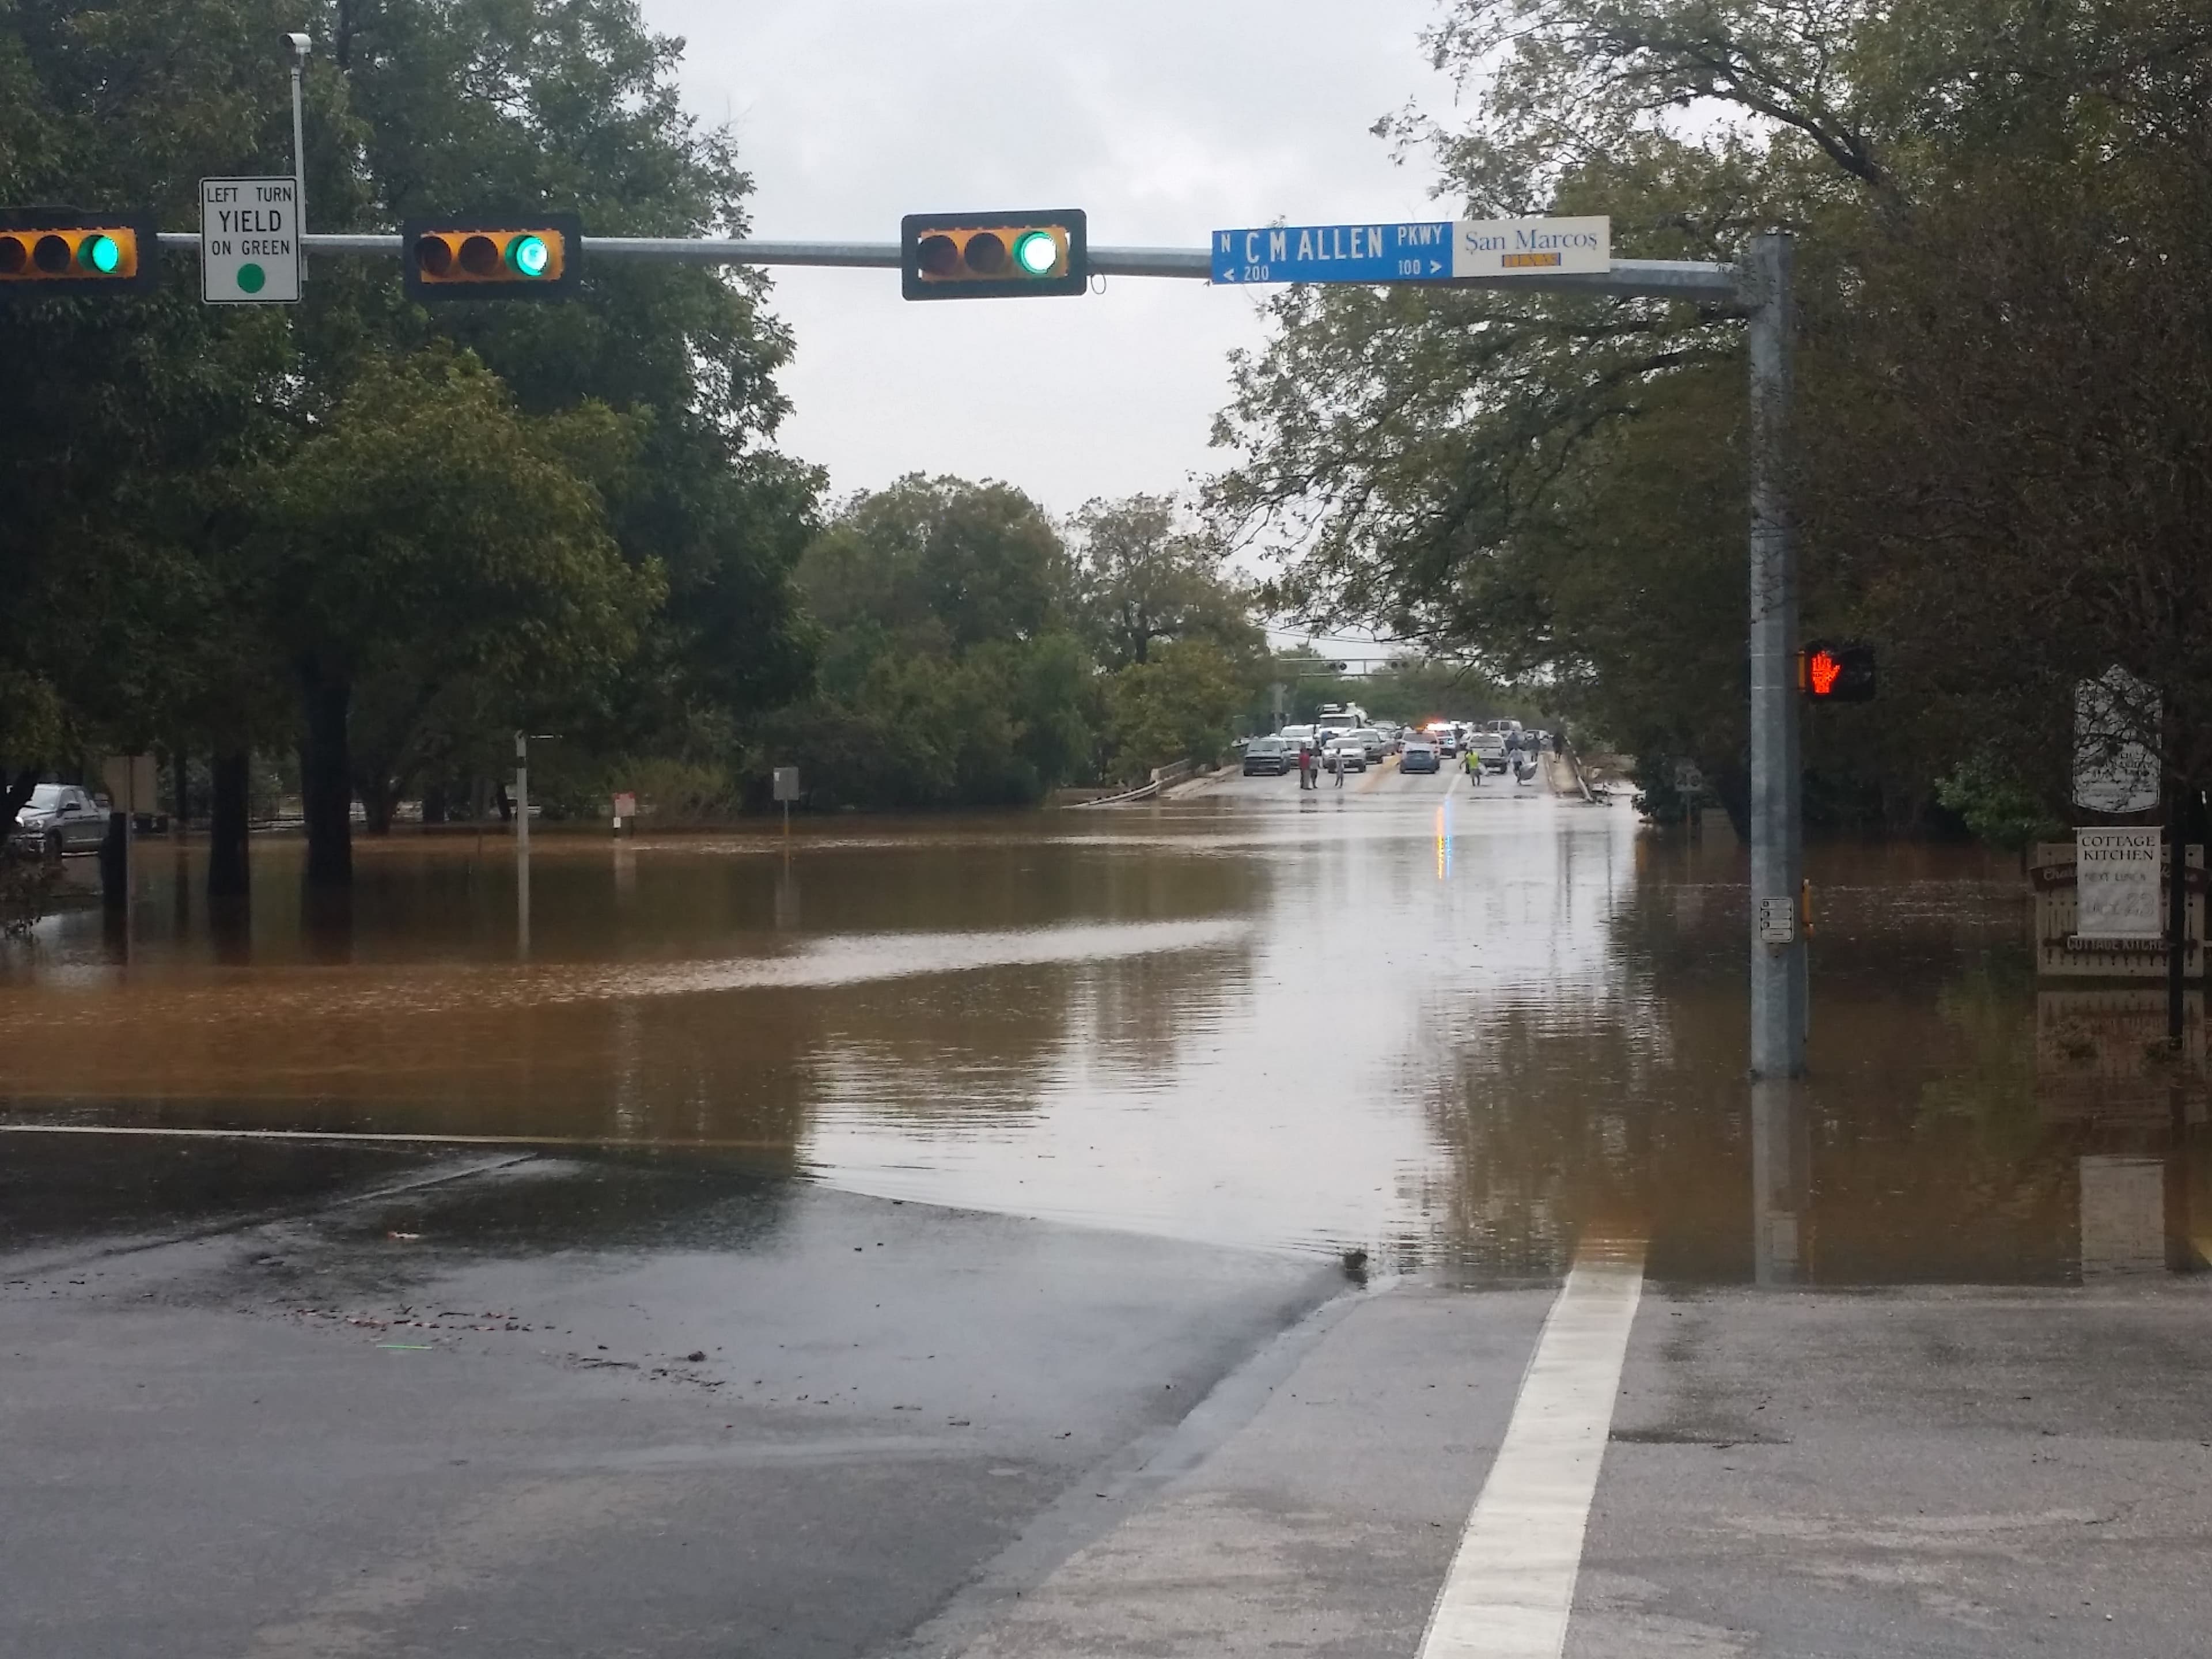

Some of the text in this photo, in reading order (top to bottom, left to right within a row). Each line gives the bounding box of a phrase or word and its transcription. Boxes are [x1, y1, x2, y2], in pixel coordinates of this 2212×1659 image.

[207, 187, 291, 202] LEFT TURN
[219, 210, 281, 233] YIELD
[212, 240, 290, 255] ON GREEN
[1221, 226, 1442, 264] N C M ALLEN PKWY
[1465, 229, 1597, 252] San Marcos
[1244, 266, 1269, 281] 200
[1399, 259, 1421, 275] 100
[2082, 836, 2155, 847] COTTAGE
[2084, 850, 2153, 860] KITCHEN
